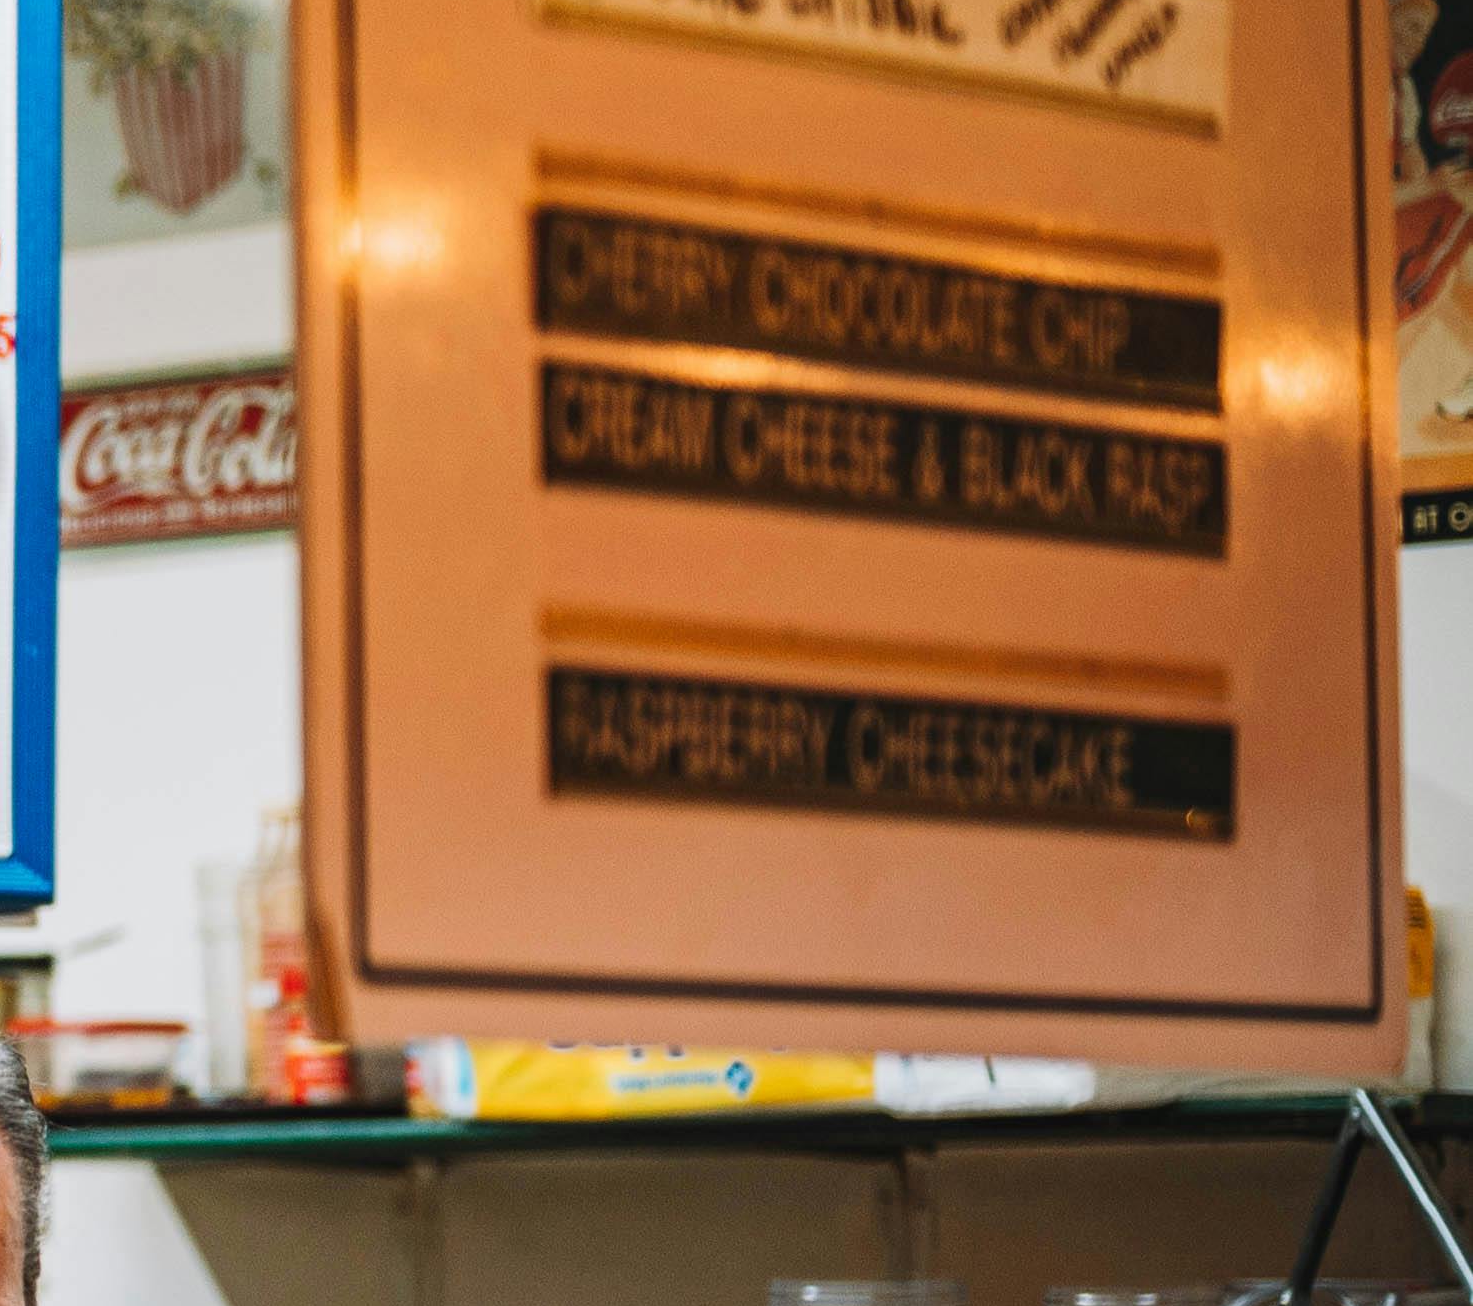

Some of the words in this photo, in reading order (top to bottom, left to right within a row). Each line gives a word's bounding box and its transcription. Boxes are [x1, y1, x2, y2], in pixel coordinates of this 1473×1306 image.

[550, 217, 735, 319] CHERRY
[757, 252, 1015, 362] CHOCOLATE
[1029, 290, 1131, 370] CHIP
[553, 377, 715, 470] CREAM
[729, 397, 900, 493] CHEESE
[961, 429, 1093, 515] BLACK
[562, 682, 831, 777] RASPBERRY
[845, 707, 1136, 807] CHEESECAKE
